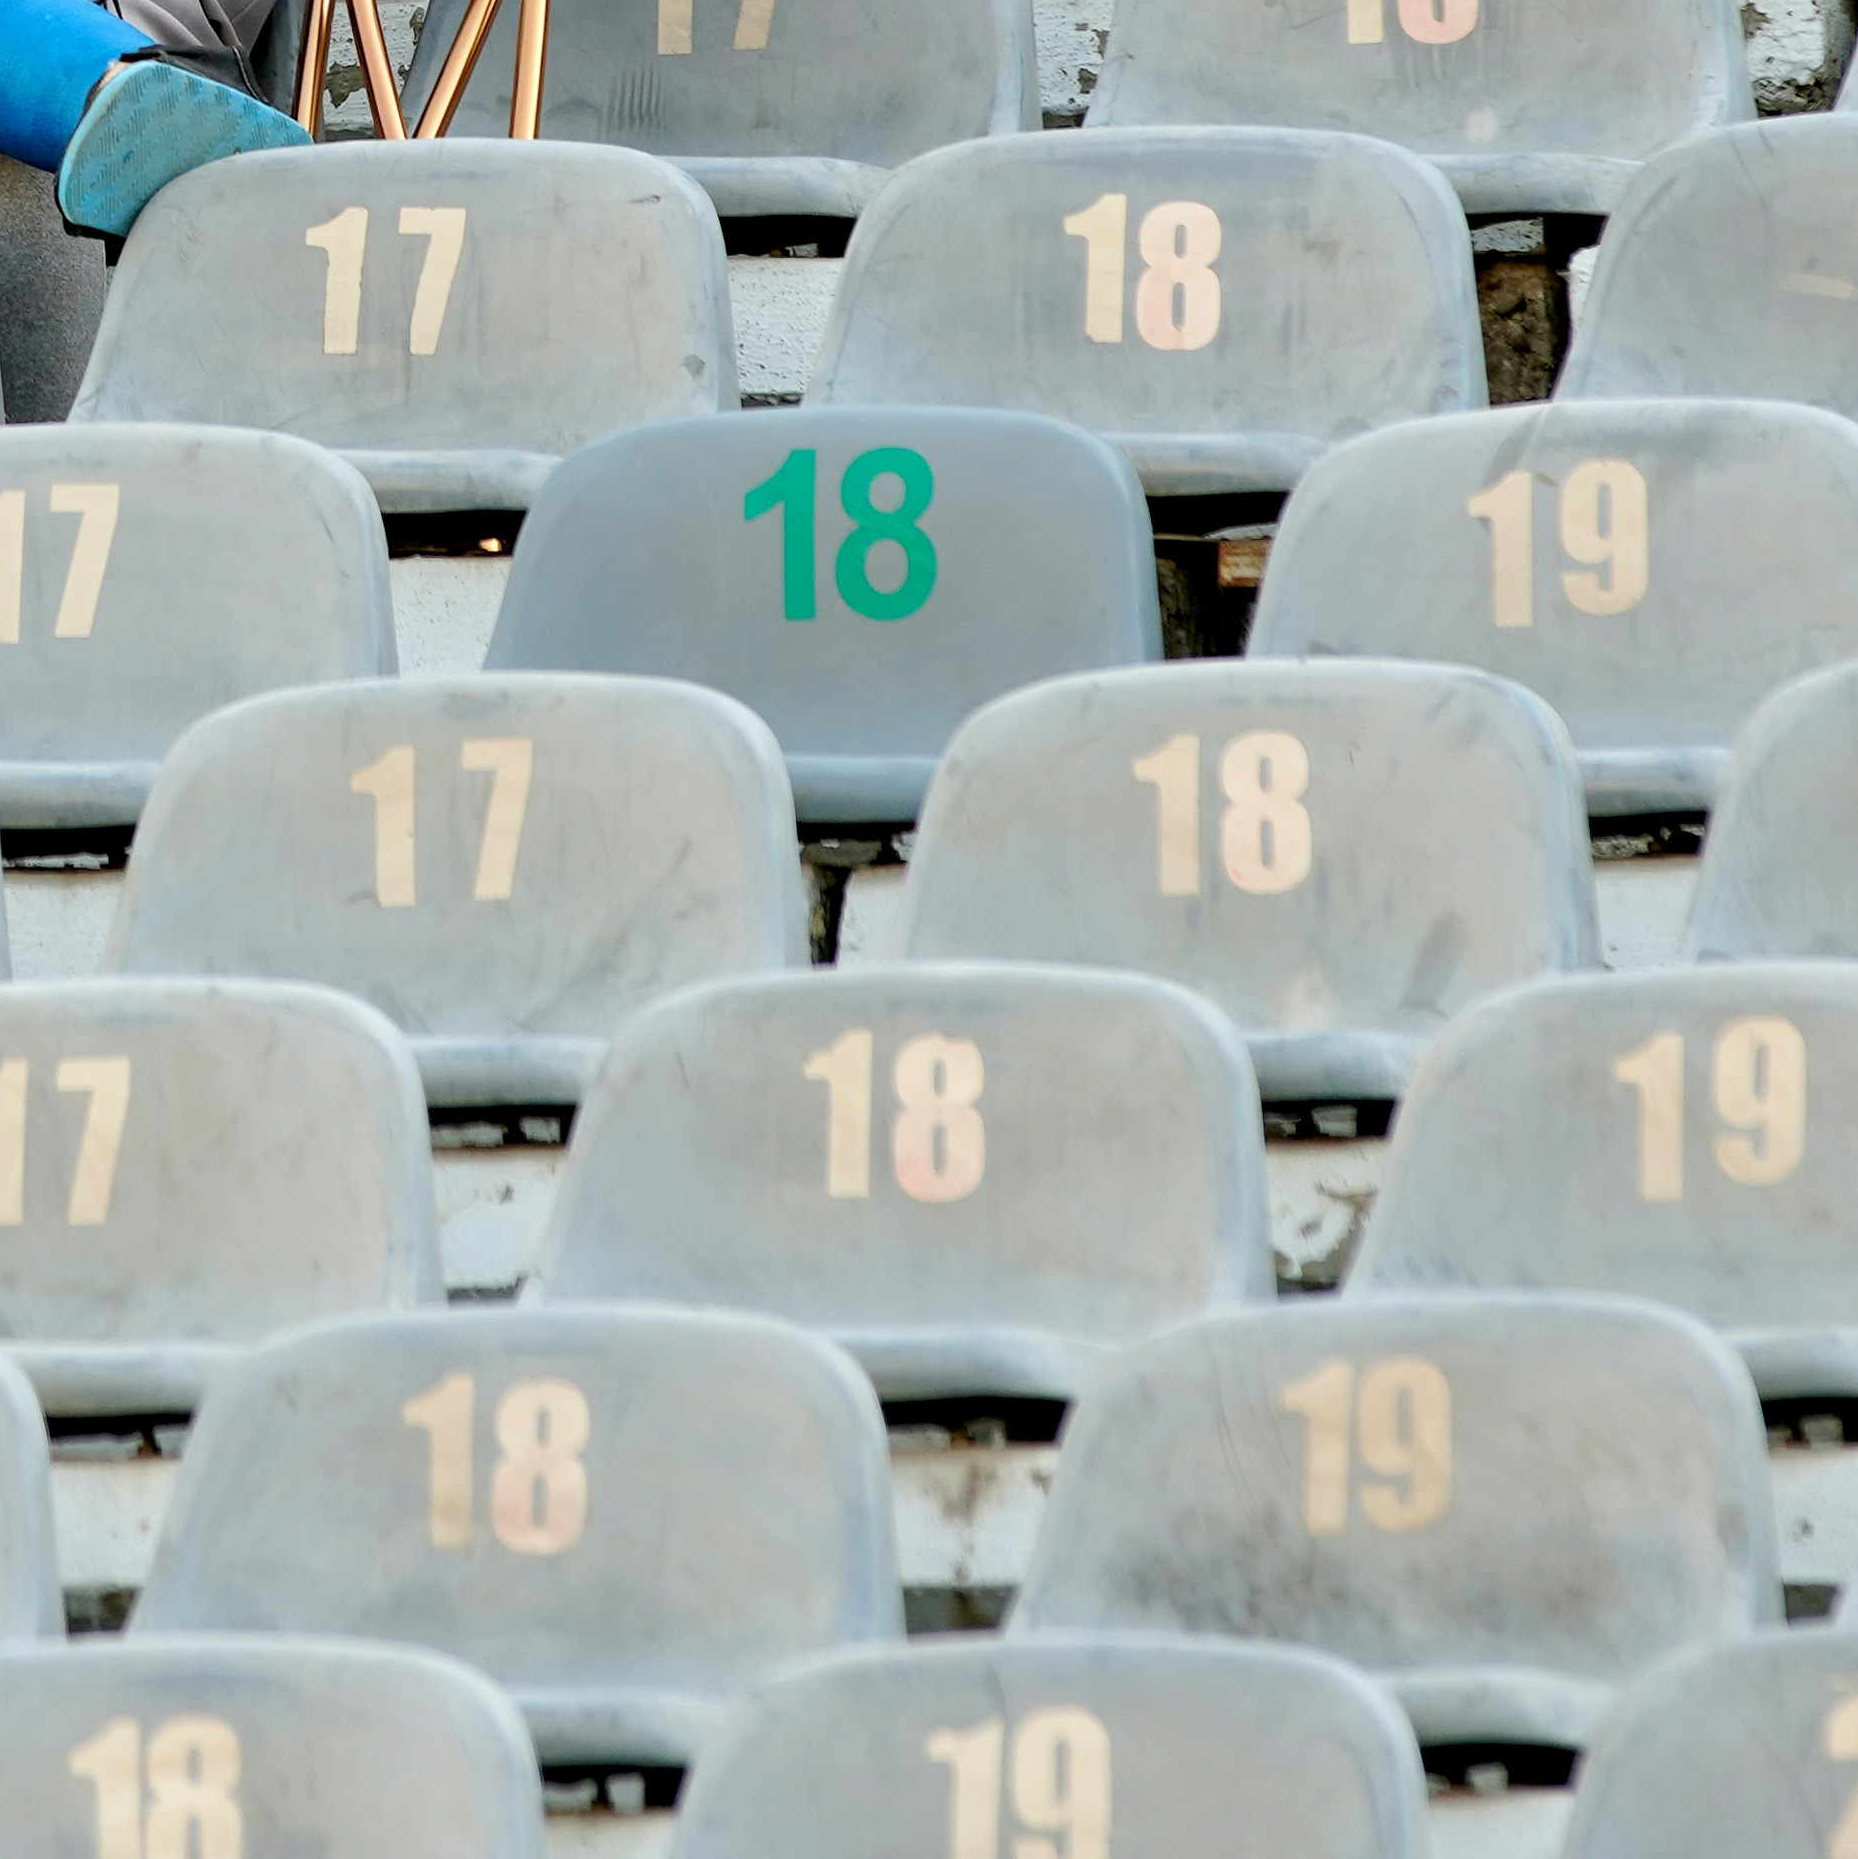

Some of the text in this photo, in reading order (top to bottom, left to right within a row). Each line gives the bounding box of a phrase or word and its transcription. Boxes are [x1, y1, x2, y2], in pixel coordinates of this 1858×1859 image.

[305, 207, 466, 356] 17
[1063, 193, 1222, 351] 18
[744, 447, 937, 621] 18
[1468, 459, 1648, 627] 19
[349, 737, 533, 905] 17
[1133, 731, 1311, 895] 18
[803, 1030, 985, 1202] 18
[1613, 1017, 1806, 1200] 19
[401, 1374, 589, 1556] 18
[1282, 1359, 1451, 1535] 19
[67, 1716, 244, 1859] 18
[926, 1706, 1113, 1859] 19
